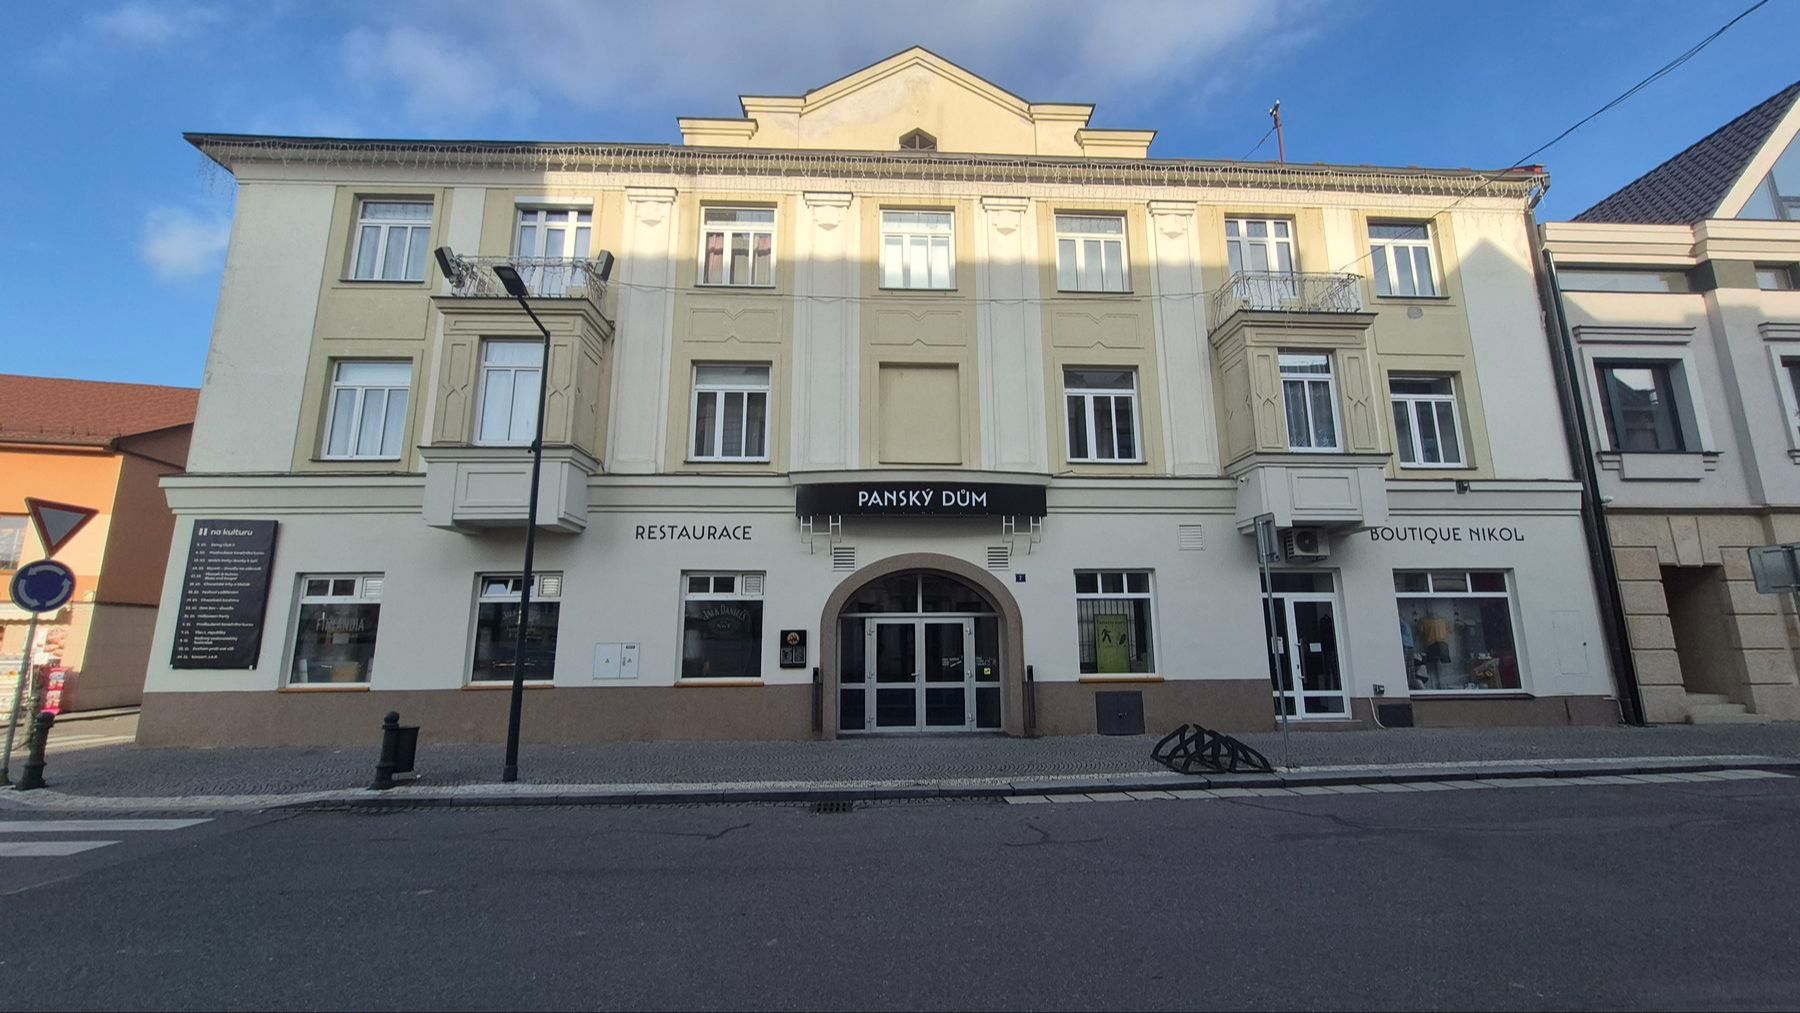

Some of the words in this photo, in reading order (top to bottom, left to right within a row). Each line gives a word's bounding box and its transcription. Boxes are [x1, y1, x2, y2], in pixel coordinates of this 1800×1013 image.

[858, 488, 934, 507] PANSKÝ
[942, 488, 987, 507] DŮM
[222, 528, 253, 536] kulturu
[635, 525, 753, 540] RESTAURACE
[1370, 526, 1462, 544] BOUTIQUE
[1468, 527, 1525, 542] NIKOL
